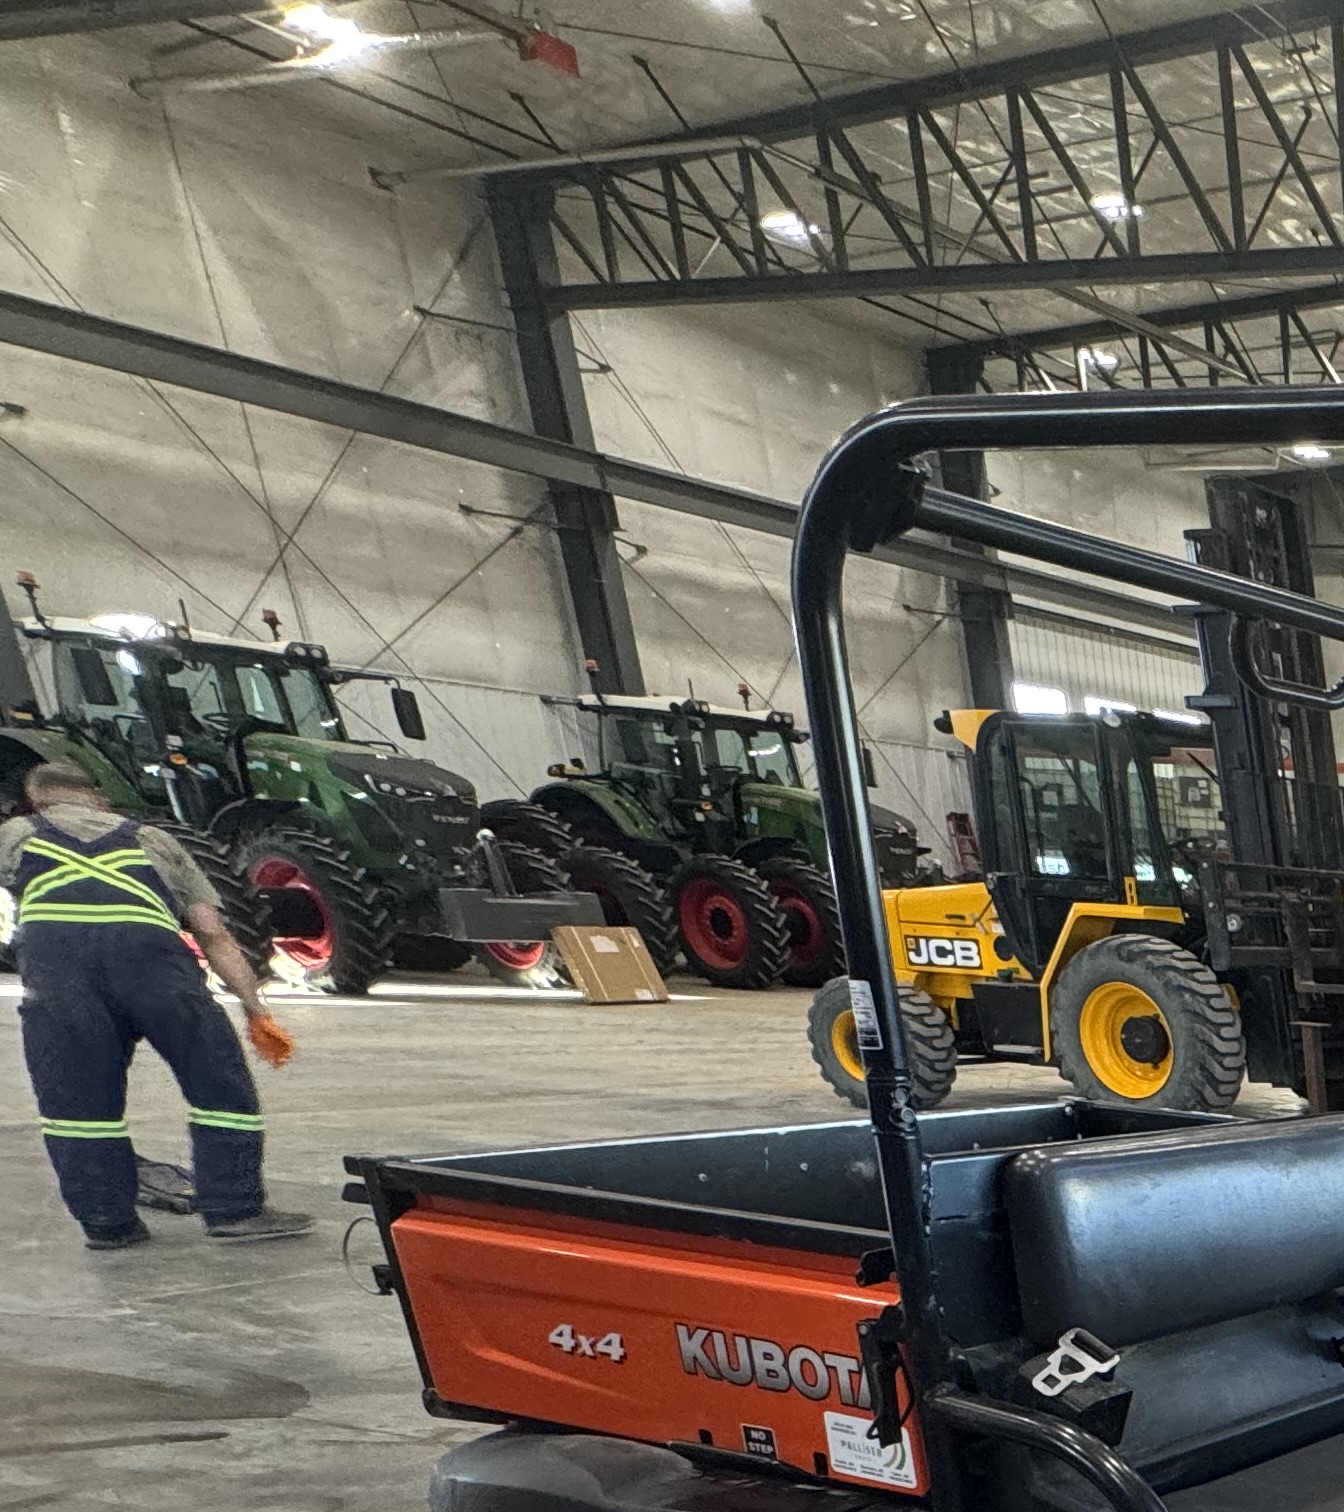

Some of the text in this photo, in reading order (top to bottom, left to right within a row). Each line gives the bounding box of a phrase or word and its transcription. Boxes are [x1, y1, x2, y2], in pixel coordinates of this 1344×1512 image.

[908, 938, 981, 968] JCB
[548, 1323, 626, 1363] 4x4
[750, 1429, 766, 1442] NO
[747, 1441, 774, 1455] STEP
